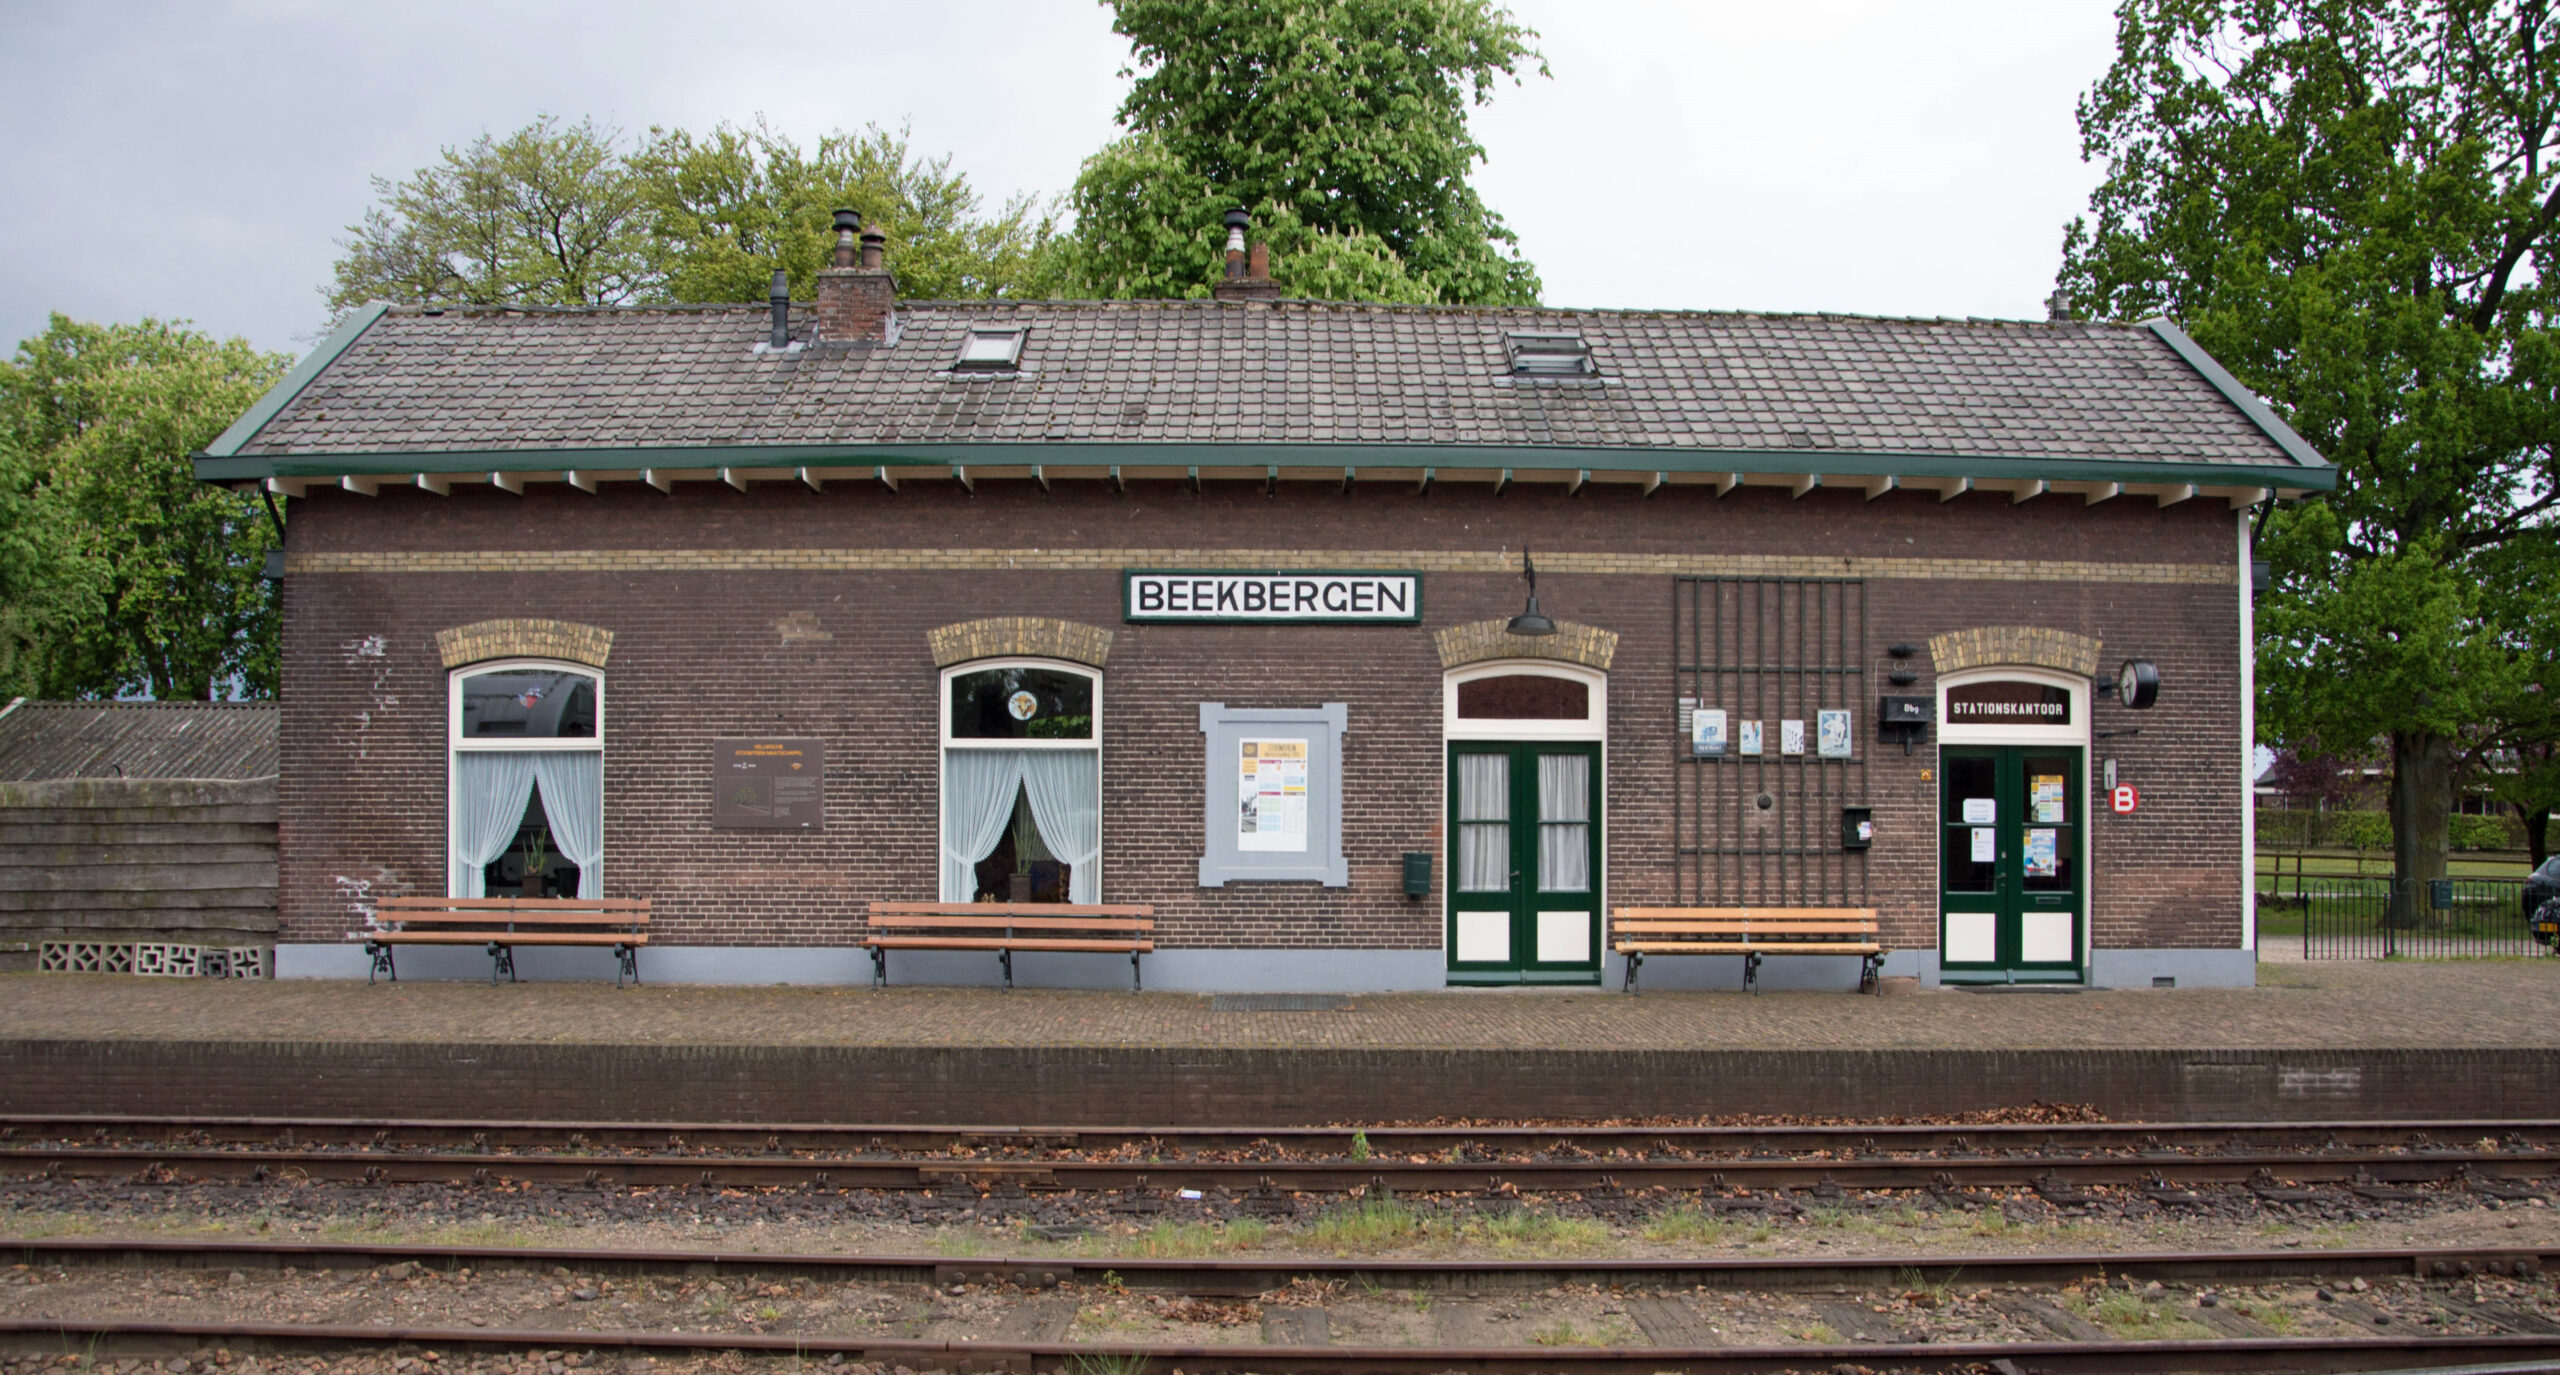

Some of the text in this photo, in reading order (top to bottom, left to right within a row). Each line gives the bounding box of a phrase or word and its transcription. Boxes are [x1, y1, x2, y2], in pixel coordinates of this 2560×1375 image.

[1138, 580, 1406, 612] BEEKBERGEN
[1903, 703, 1919, 714] Bbg
[1953, 702, 2064, 715] STATIONSKANTOOR
[2114, 786, 2134, 812] B
